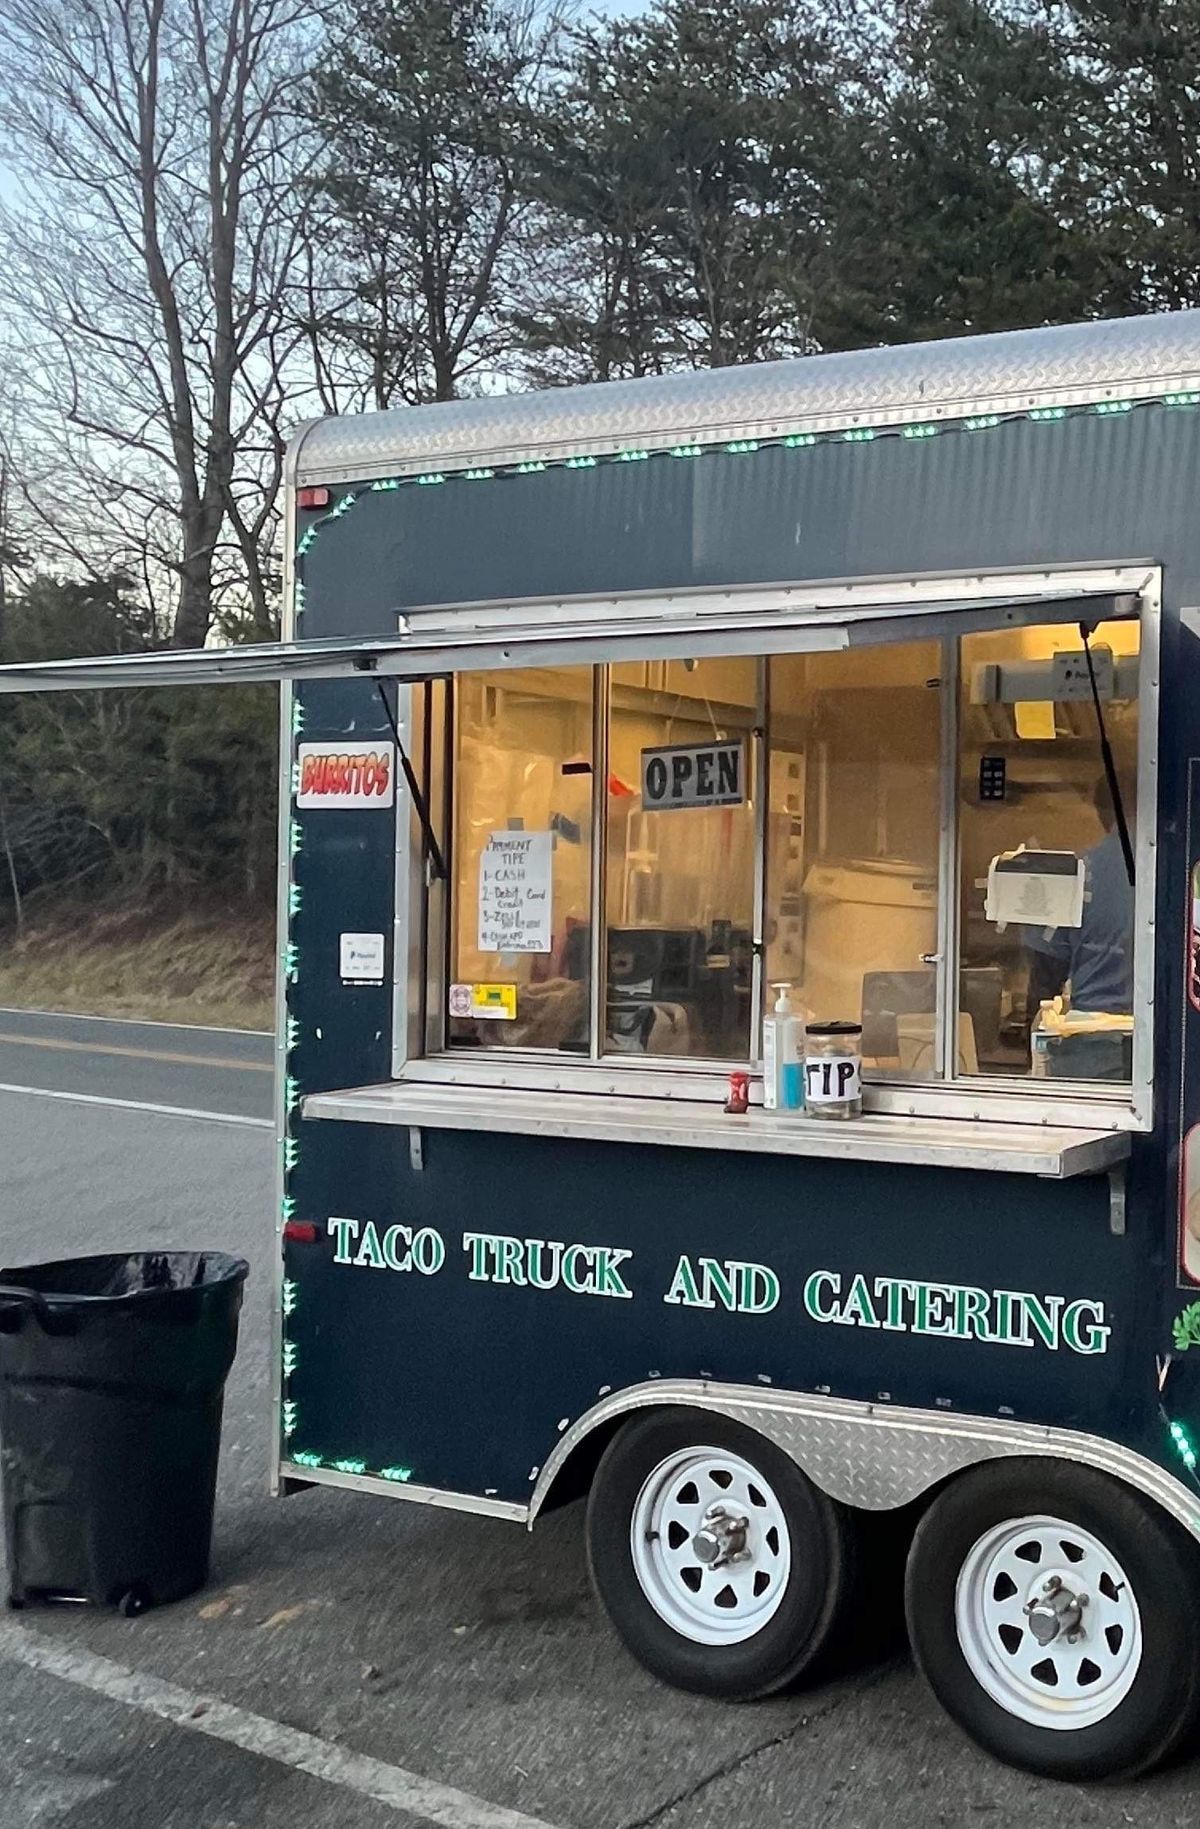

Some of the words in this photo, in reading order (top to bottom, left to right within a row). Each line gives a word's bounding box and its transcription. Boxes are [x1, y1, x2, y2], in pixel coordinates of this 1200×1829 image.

[300, 751, 390, 796] BURRITOS
[646, 750, 738, 799] OPEN
[326, 1216, 446, 1277] TACO
[461, 1231, 633, 1299] TRUCK
[664, 1254, 780, 1315] AND
[803, 1270, 1114, 1355] CATERING
